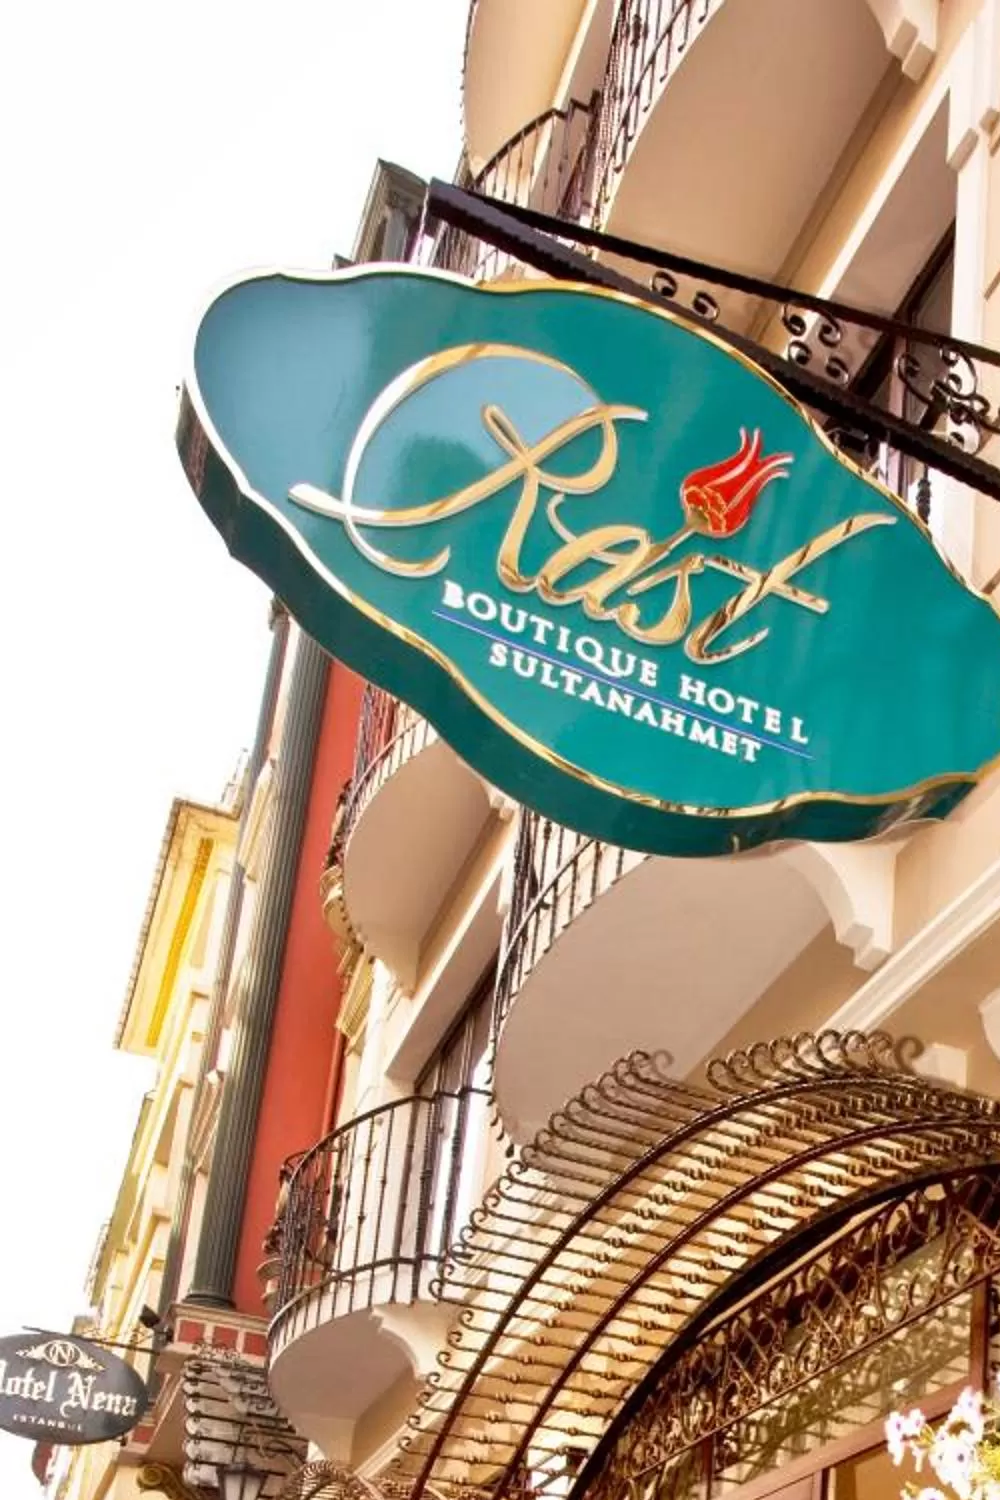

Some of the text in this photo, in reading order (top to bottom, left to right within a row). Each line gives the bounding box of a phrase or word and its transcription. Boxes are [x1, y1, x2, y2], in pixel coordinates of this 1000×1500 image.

[289, 343, 896, 664] Rast
[443, 580, 808, 745] BOUTIQUE HOTEL
[489, 642, 762, 763] SULTANAHMET
